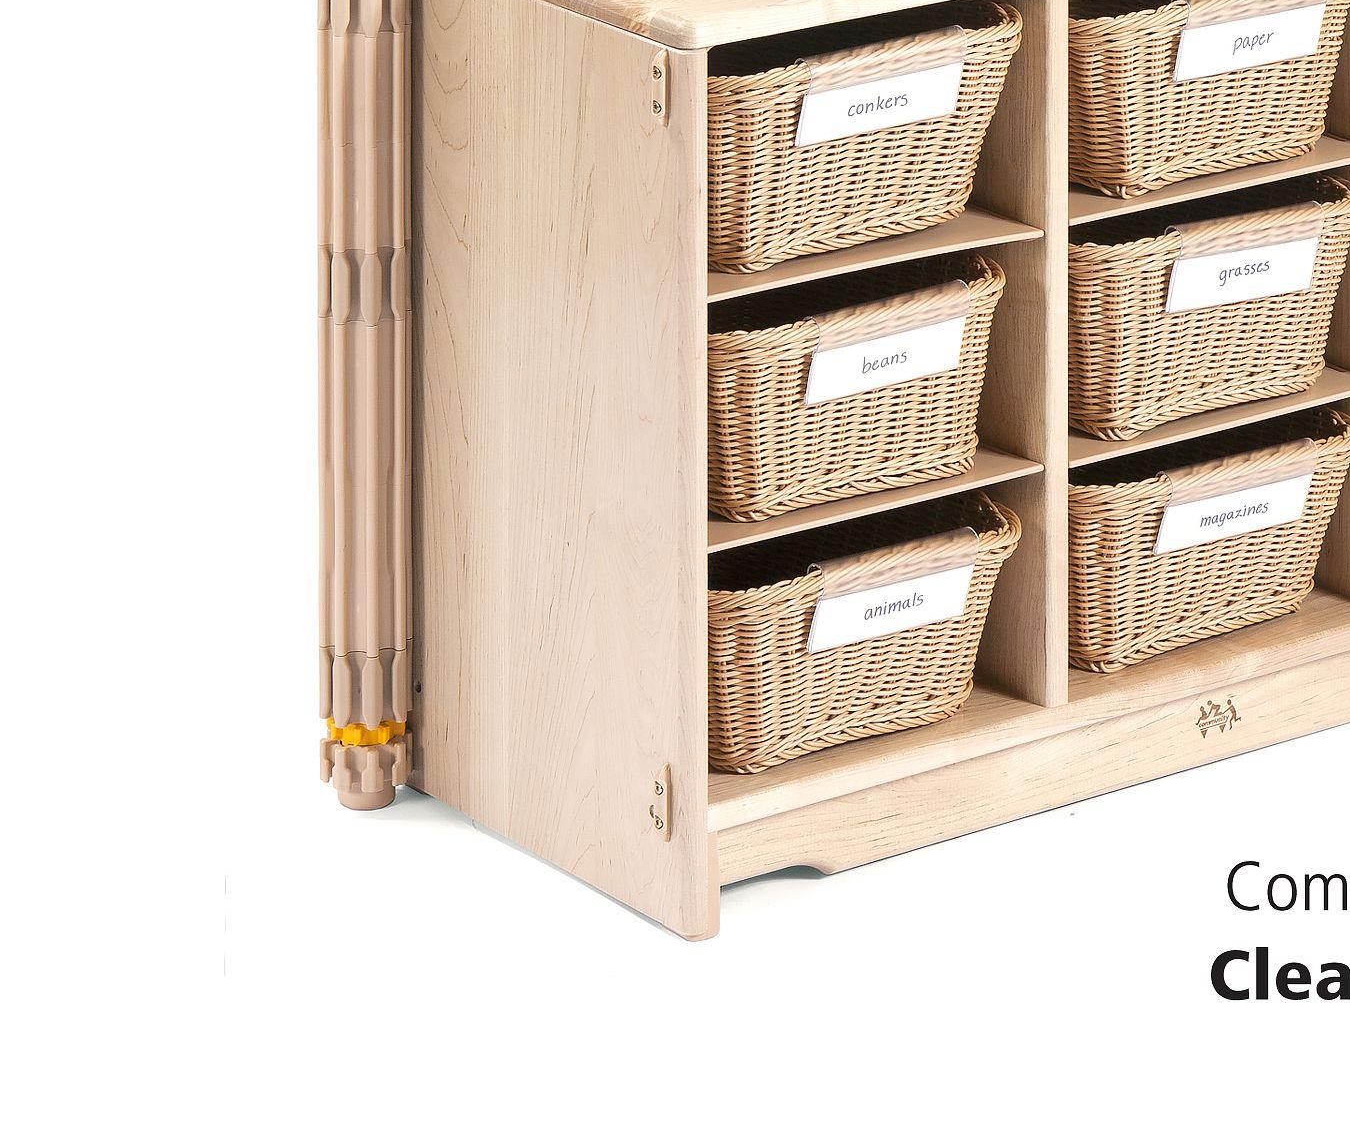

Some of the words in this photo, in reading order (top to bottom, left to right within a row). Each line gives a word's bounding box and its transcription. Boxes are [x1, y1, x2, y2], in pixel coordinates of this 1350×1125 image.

[1232, 31, 1274, 55] paper
[847, 93, 908, 117] conkers
[1218, 258, 1271, 286] grasses
[861, 349, 908, 374] beans
[1199, 500, 1270, 529] magazines
[863, 592, 925, 621] animals
[1199, 715, 1229, 728] community
